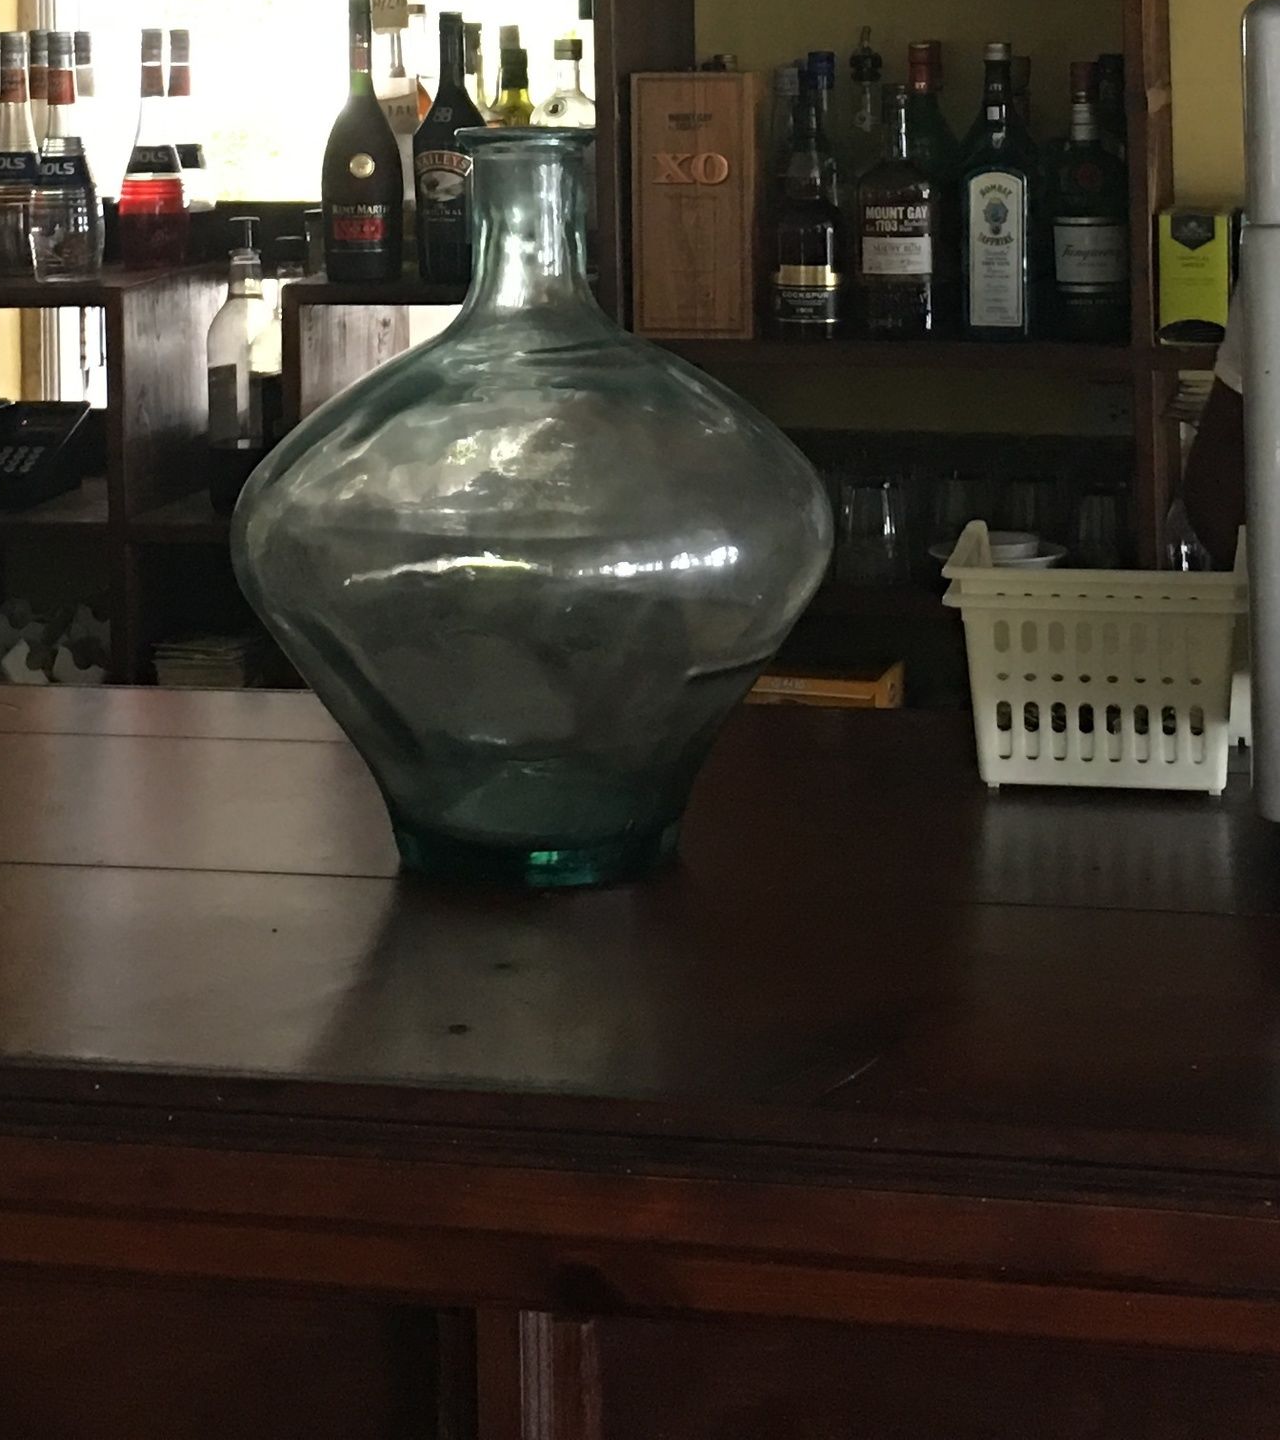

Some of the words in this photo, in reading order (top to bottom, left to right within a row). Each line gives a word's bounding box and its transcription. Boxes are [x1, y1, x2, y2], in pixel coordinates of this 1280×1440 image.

[651, 152, 730, 186] XO
[979, 184, 1013, 199] BOMBAY
[865, 205, 905, 220] MOUNT
[906, 205, 928, 220] GAY
